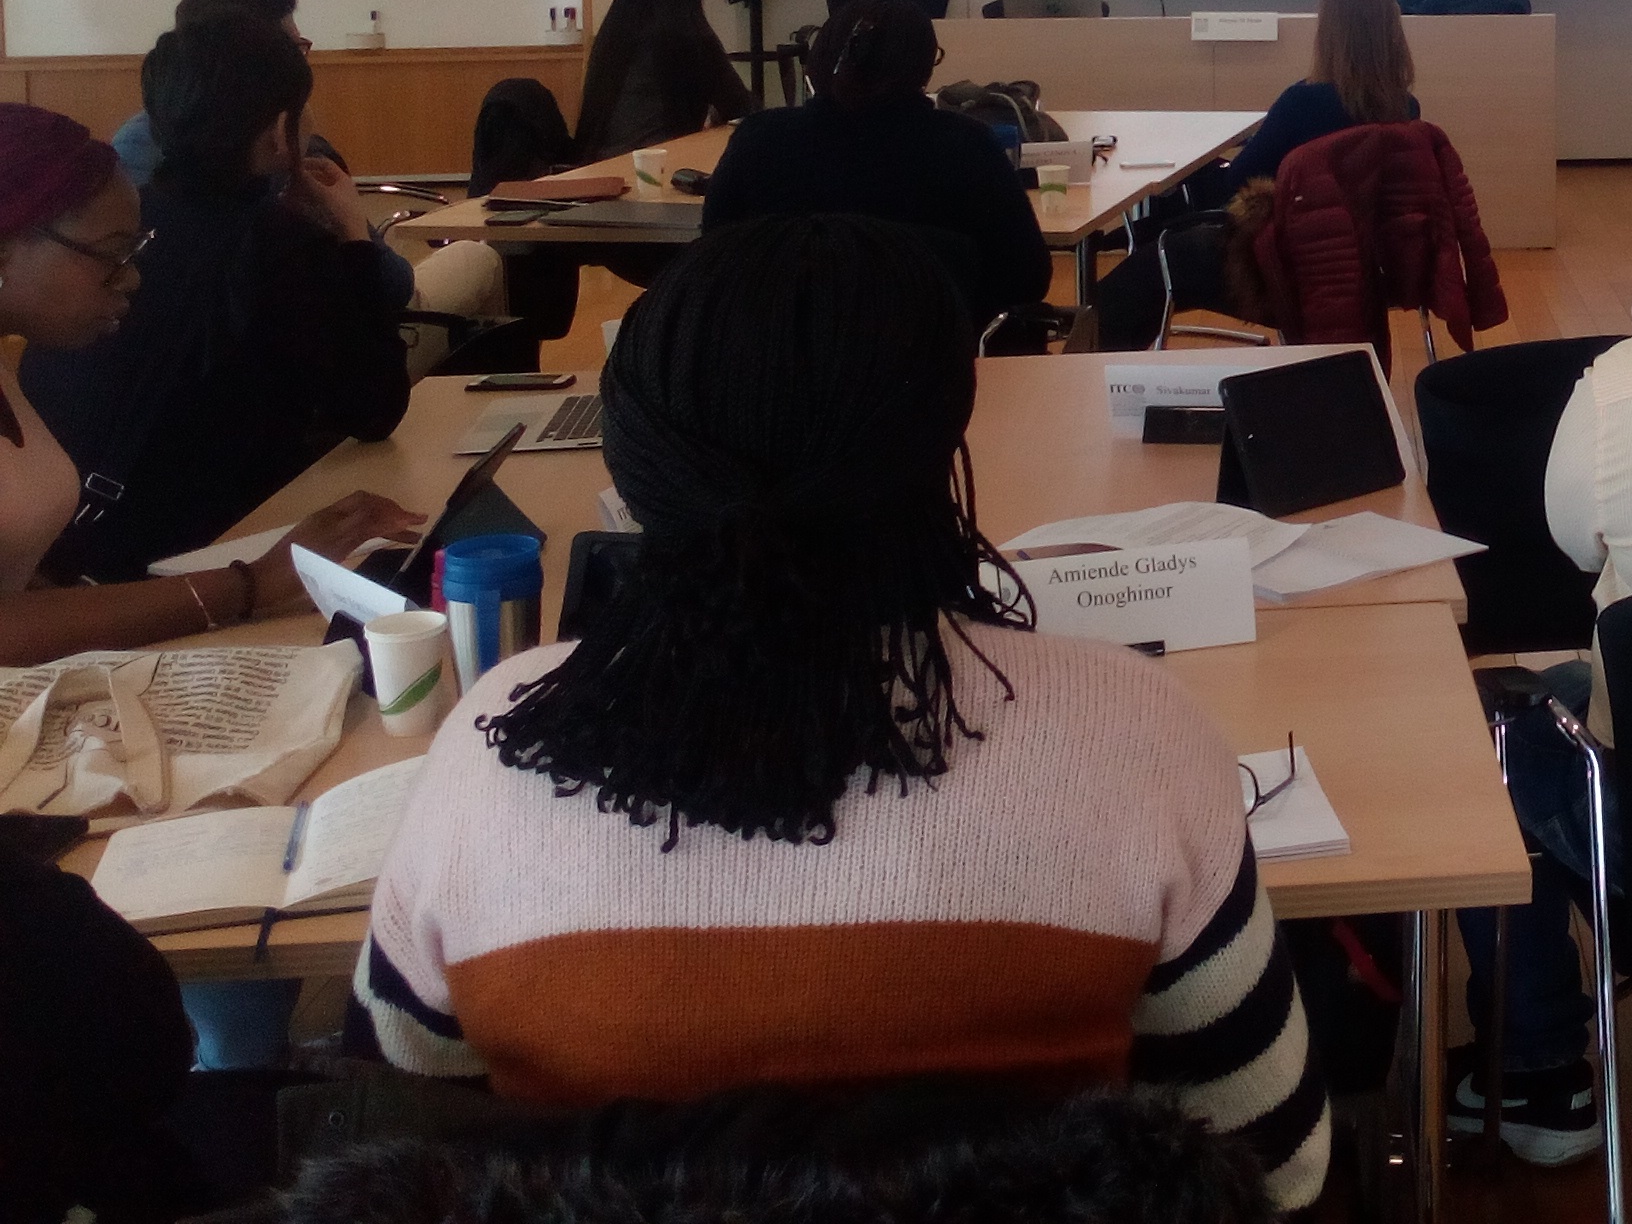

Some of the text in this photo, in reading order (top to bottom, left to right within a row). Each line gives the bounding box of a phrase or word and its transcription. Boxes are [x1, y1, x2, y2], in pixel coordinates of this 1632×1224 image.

[1048, 553, 1198, 585] Amiende Gladys
[1076, 584, 1174, 608] Onoghinor
